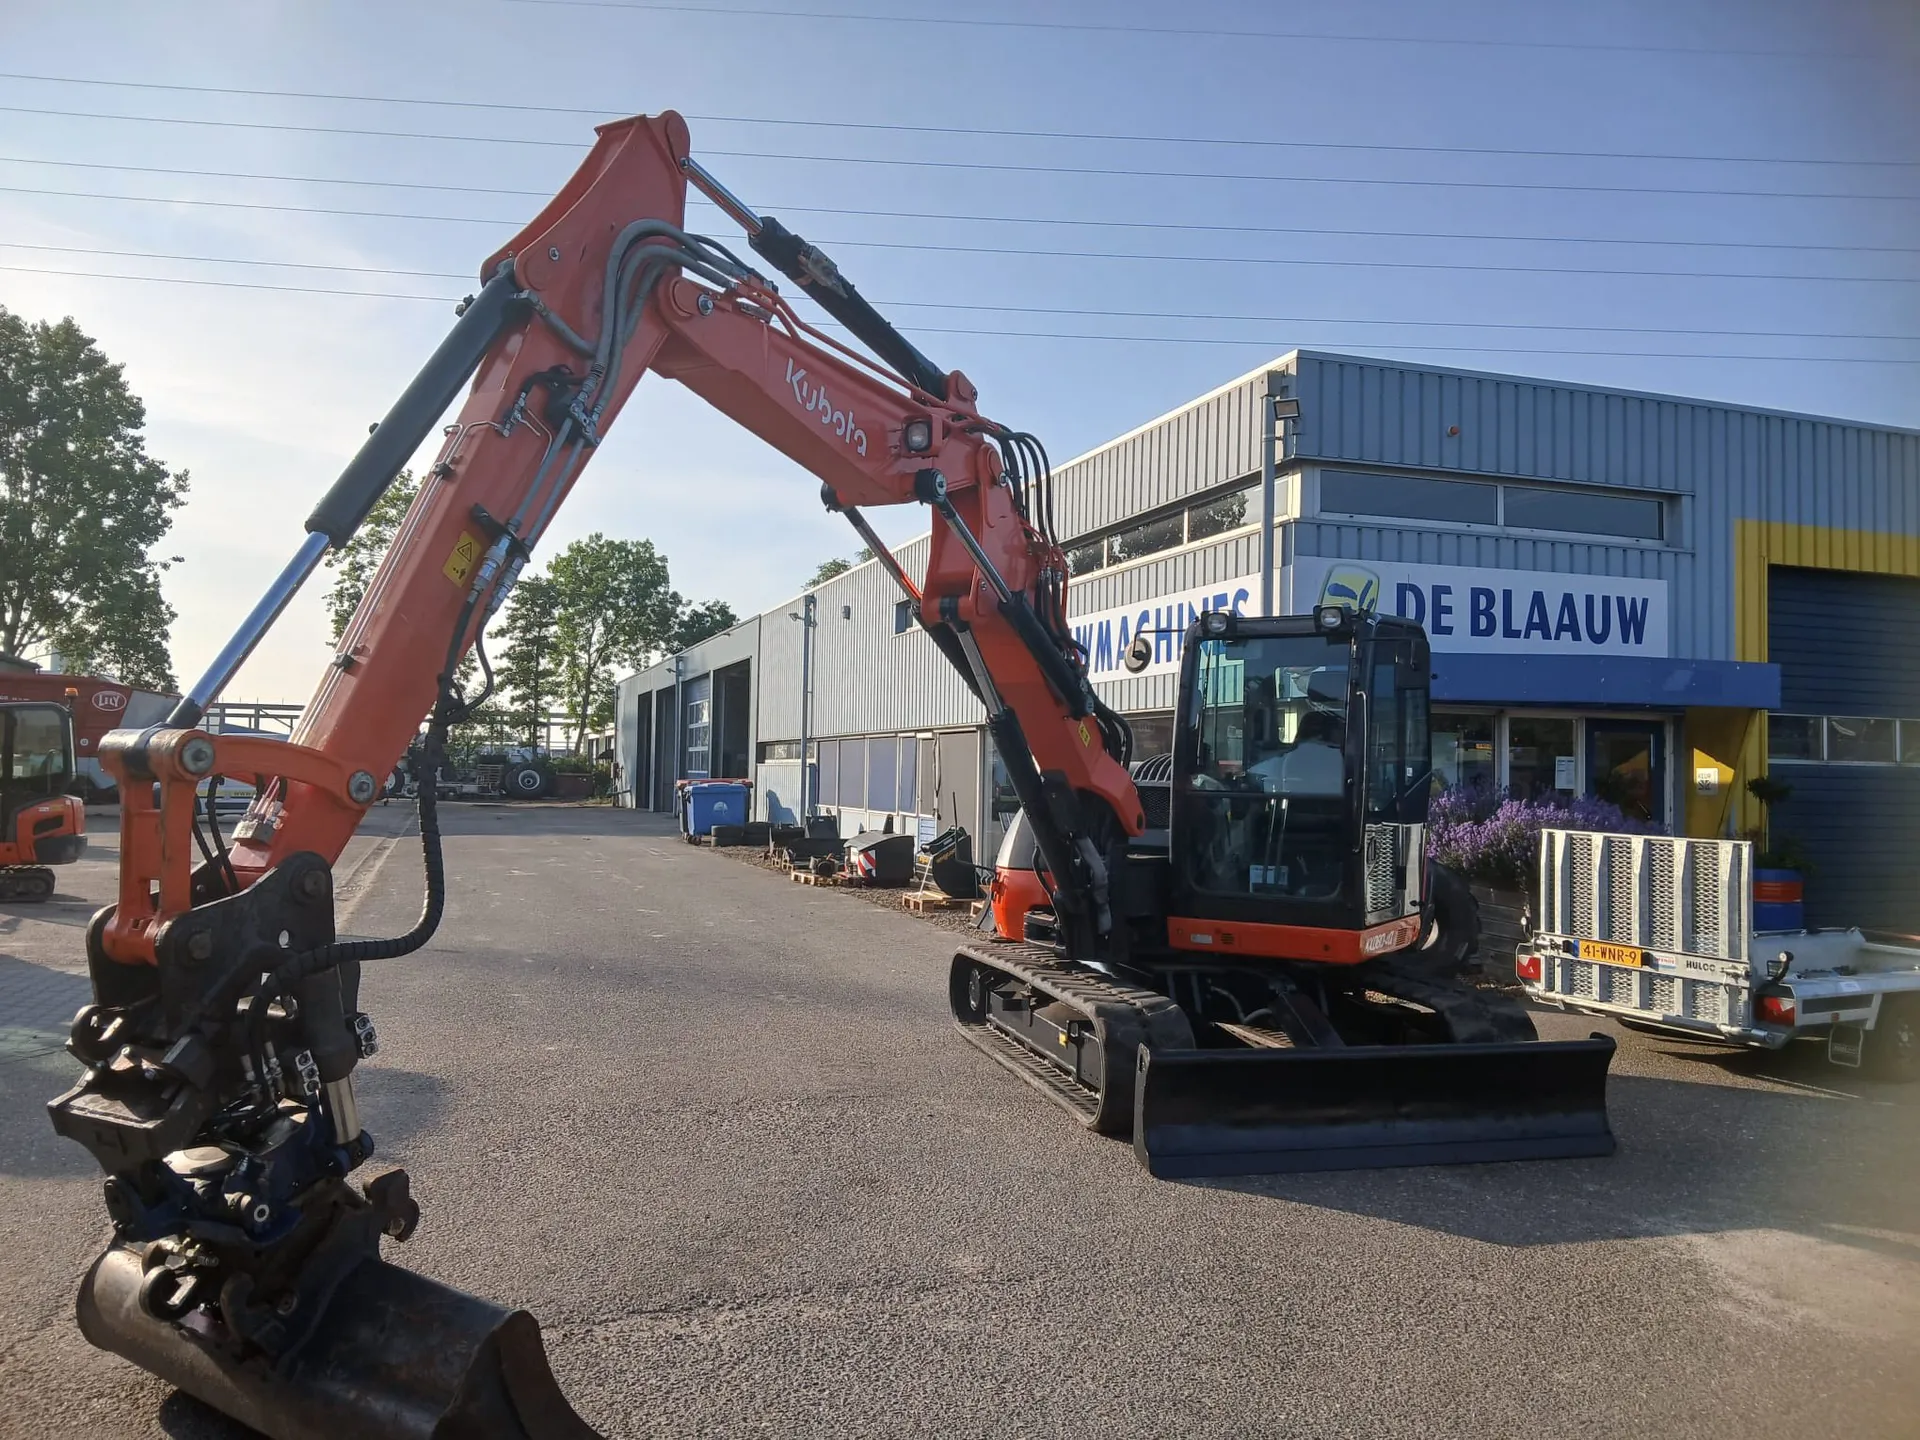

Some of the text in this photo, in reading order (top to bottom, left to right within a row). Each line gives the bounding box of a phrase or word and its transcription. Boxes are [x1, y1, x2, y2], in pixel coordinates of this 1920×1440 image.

[786, 357, 867, 457] Kubota
[1396, 582, 1649, 645] DE BLAAUW
[1583, 944, 1637, 965] 41-WNR-9
